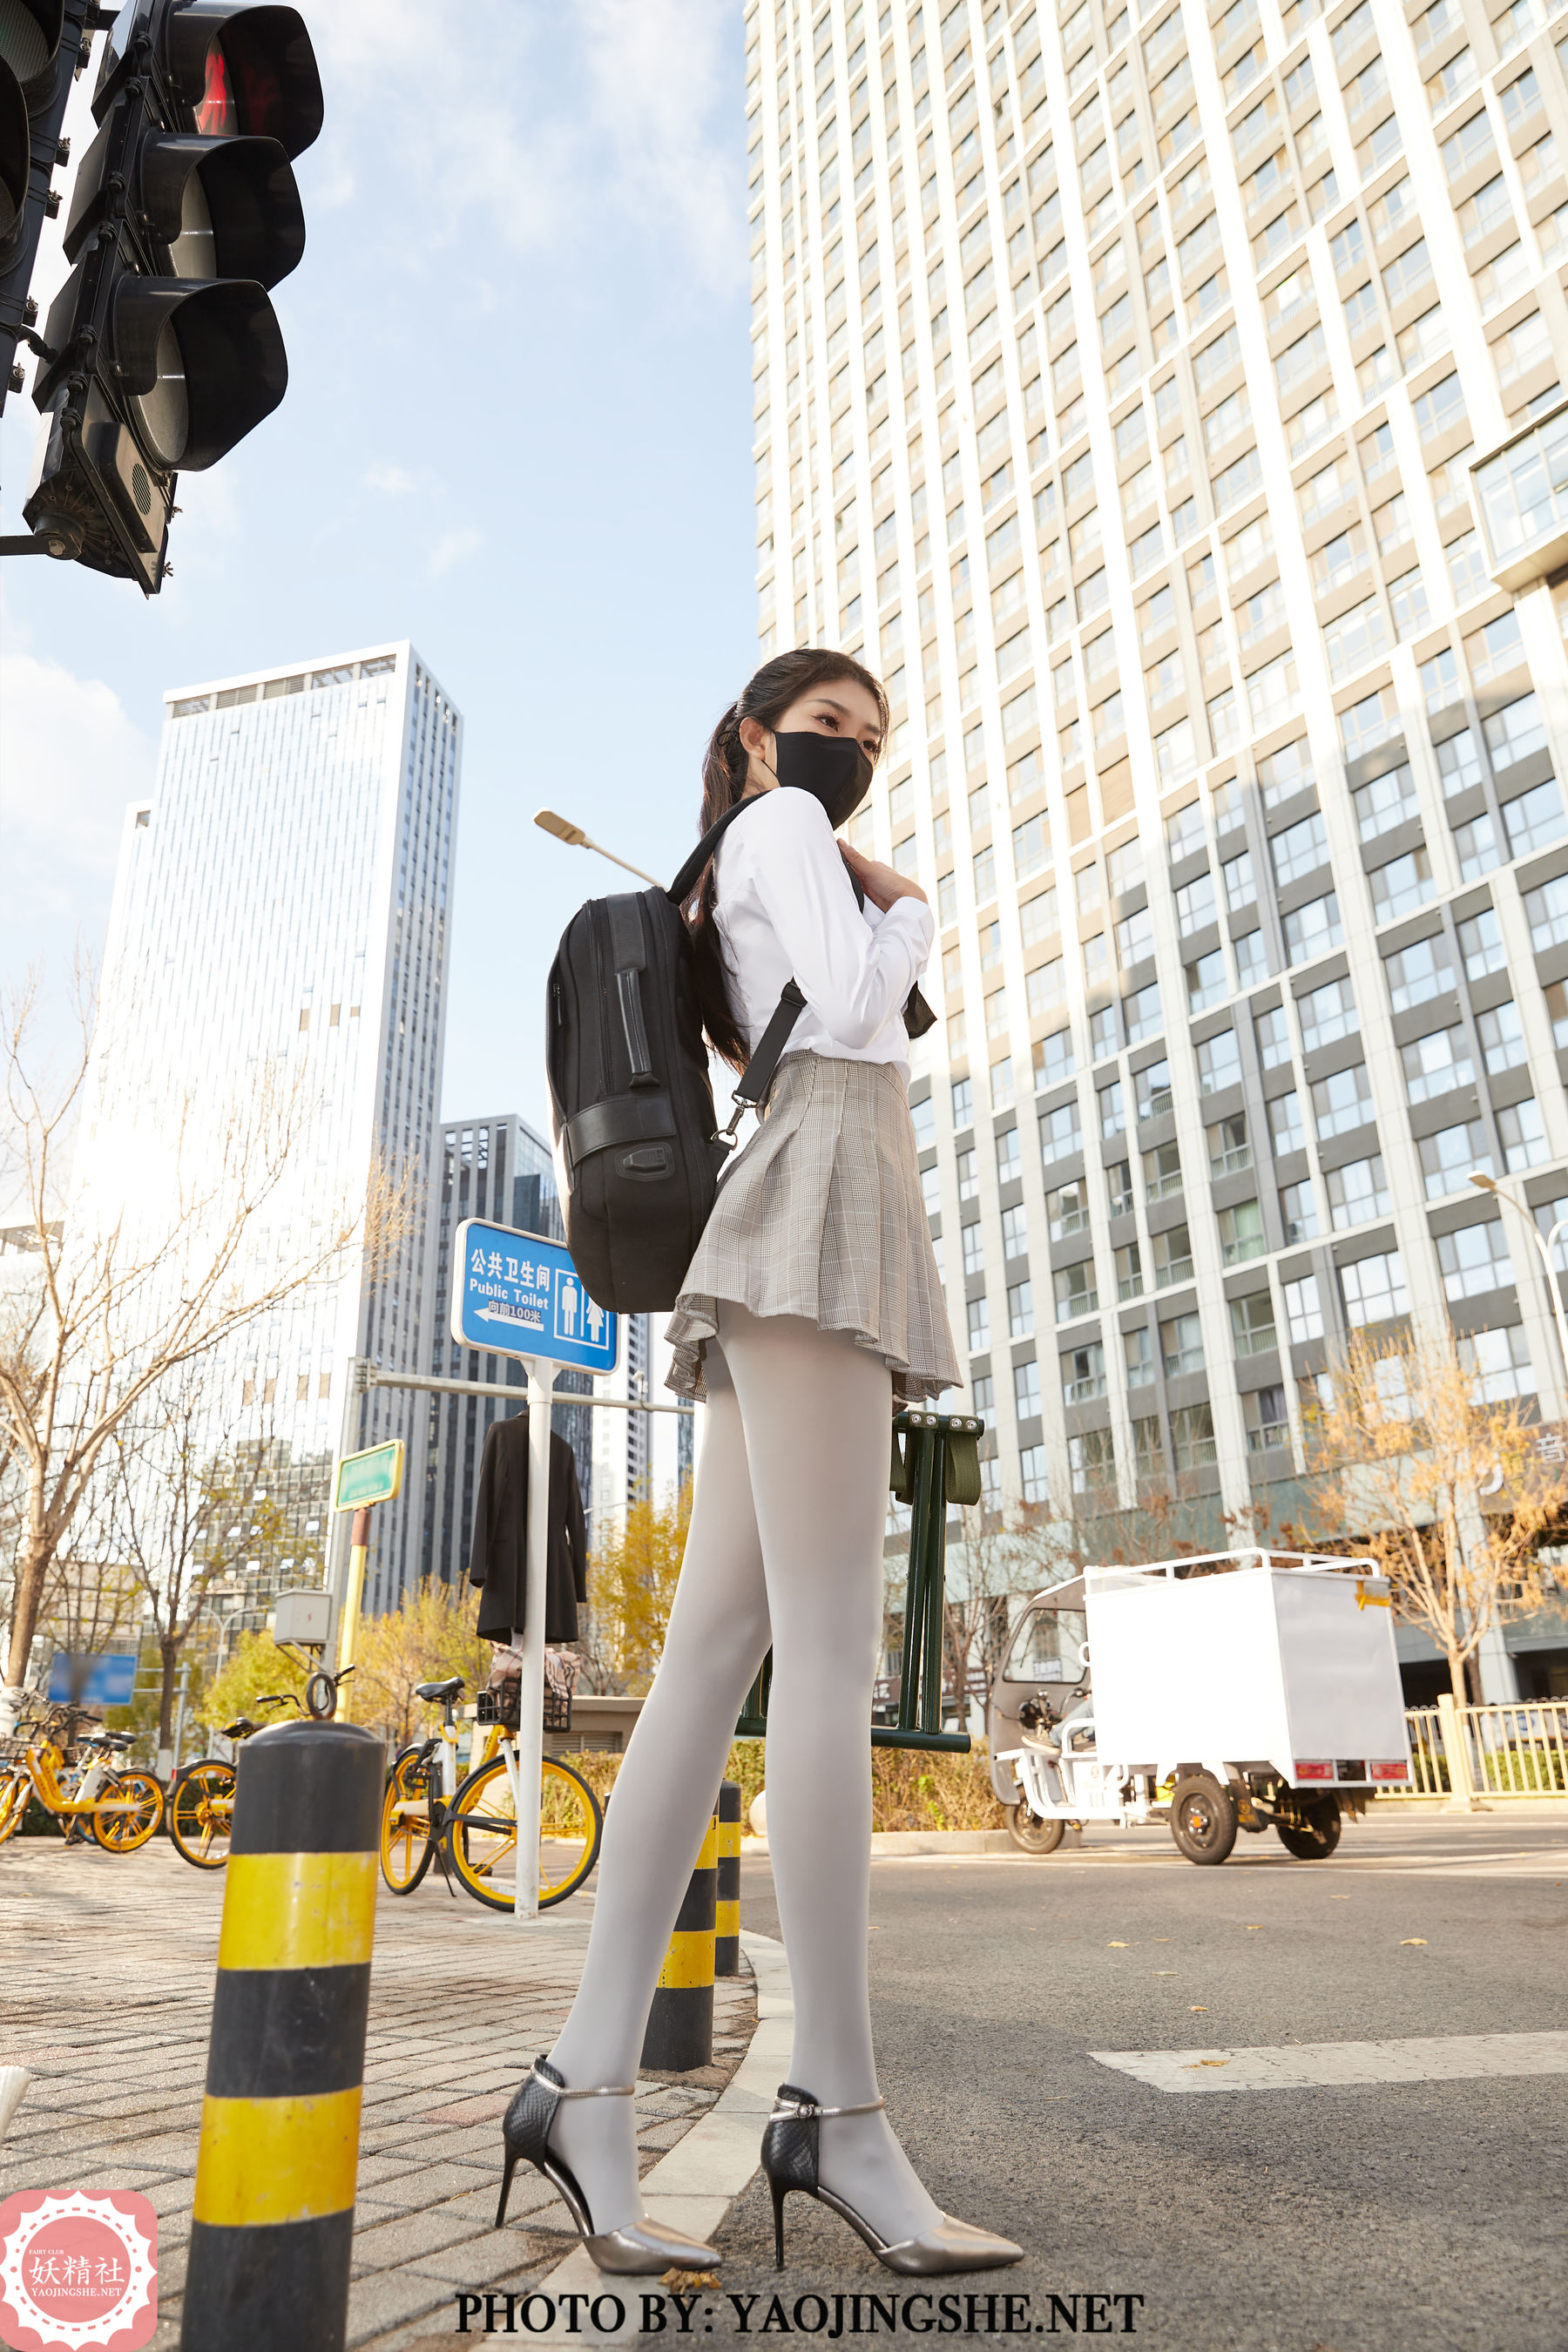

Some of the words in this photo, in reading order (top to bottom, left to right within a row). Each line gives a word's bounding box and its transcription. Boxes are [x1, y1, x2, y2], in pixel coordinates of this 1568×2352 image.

[471, 1248, 551, 1293] 公共卫生间
[470, 1278, 508, 1300] Public
[514, 1289, 549, 1310] Toilet
[488, 1300, 542, 1323] 向前100米
